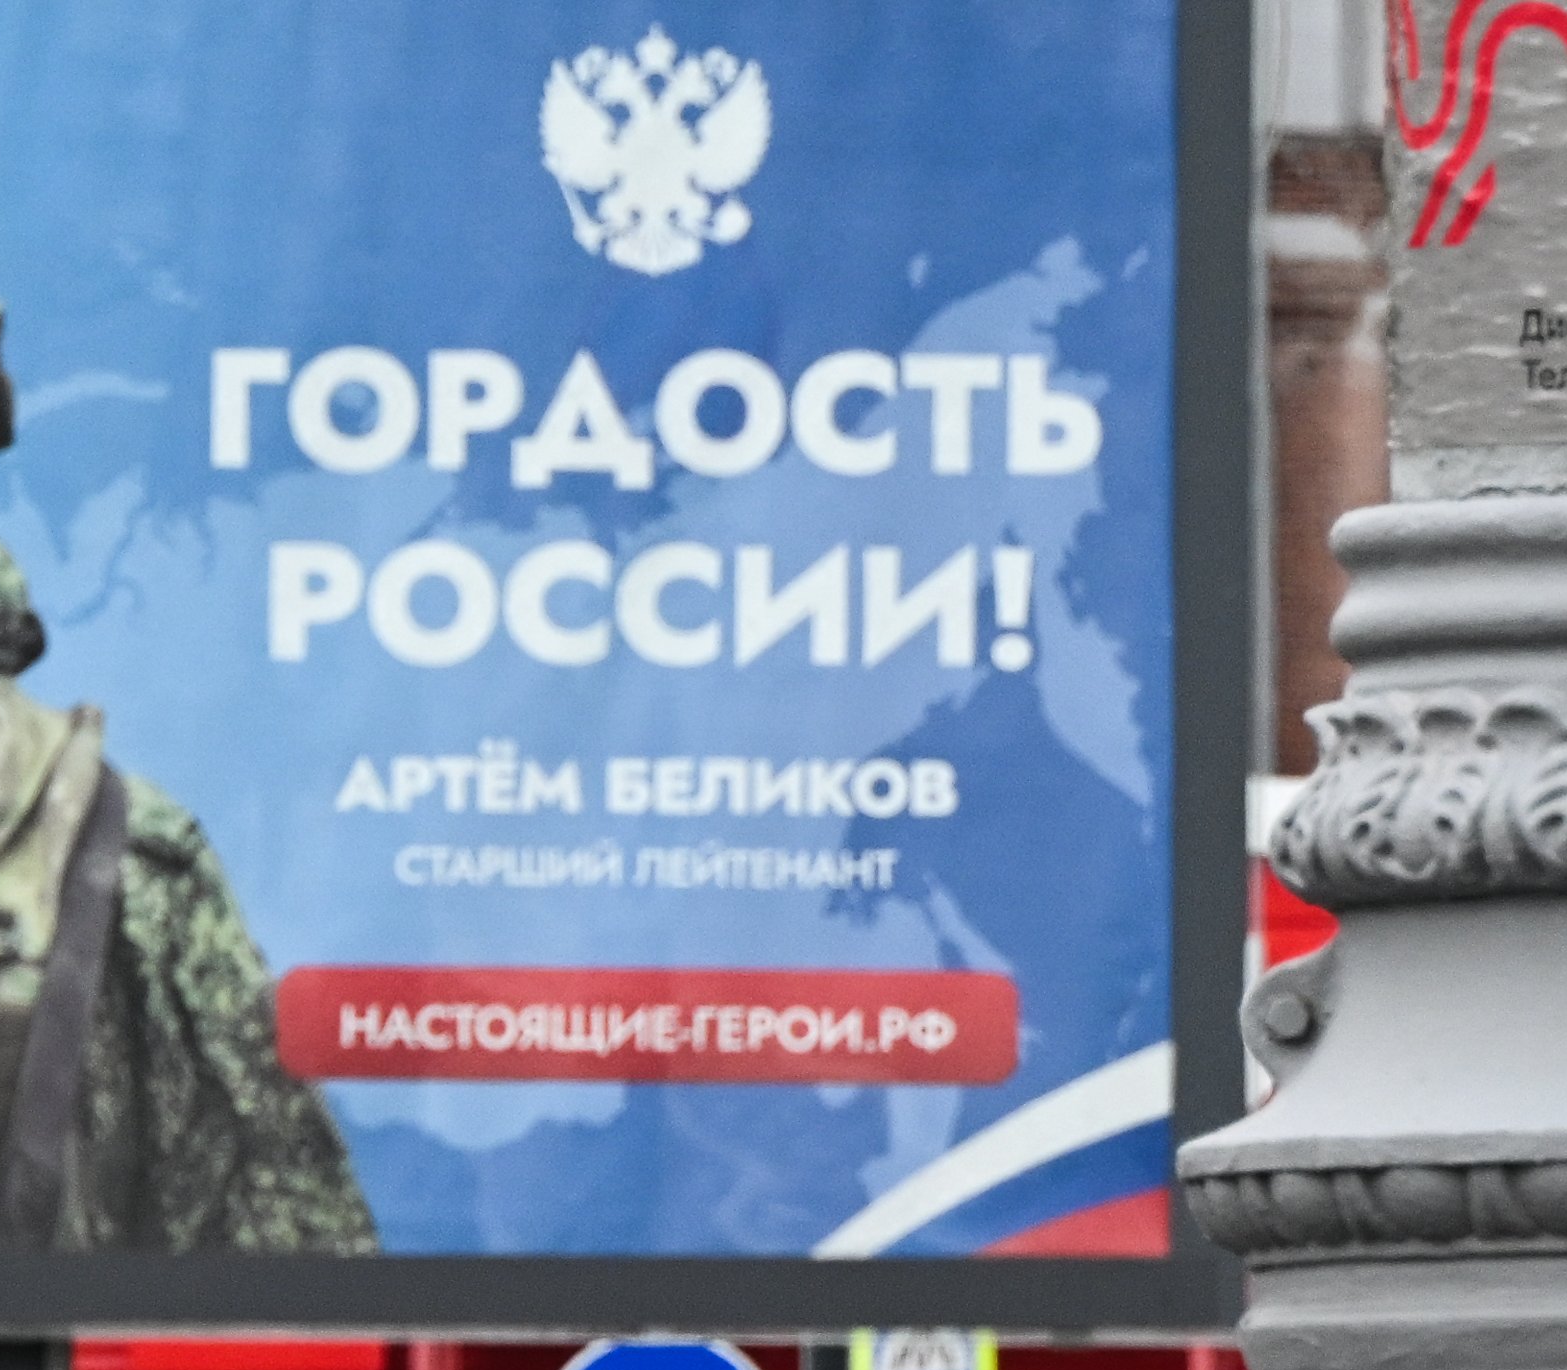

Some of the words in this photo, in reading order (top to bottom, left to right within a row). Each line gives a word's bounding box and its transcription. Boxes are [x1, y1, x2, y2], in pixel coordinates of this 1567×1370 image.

[209, 346, 1102, 490] ГОРДОСТЬ
[267, 538, 1034, 674] РОССИИ!
[333, 738, 584, 814] АРТЁМ
[603, 754, 959, 818] БЕЛИКОВ
[393, 838, 624, 888] СТАРШИЙ
[631, 838, 900, 890] ЛЕЙТЕНАНТ
[338, 1003, 958, 1056] НАСТОЯЩИЕ-ГЕРОИ.РФ
